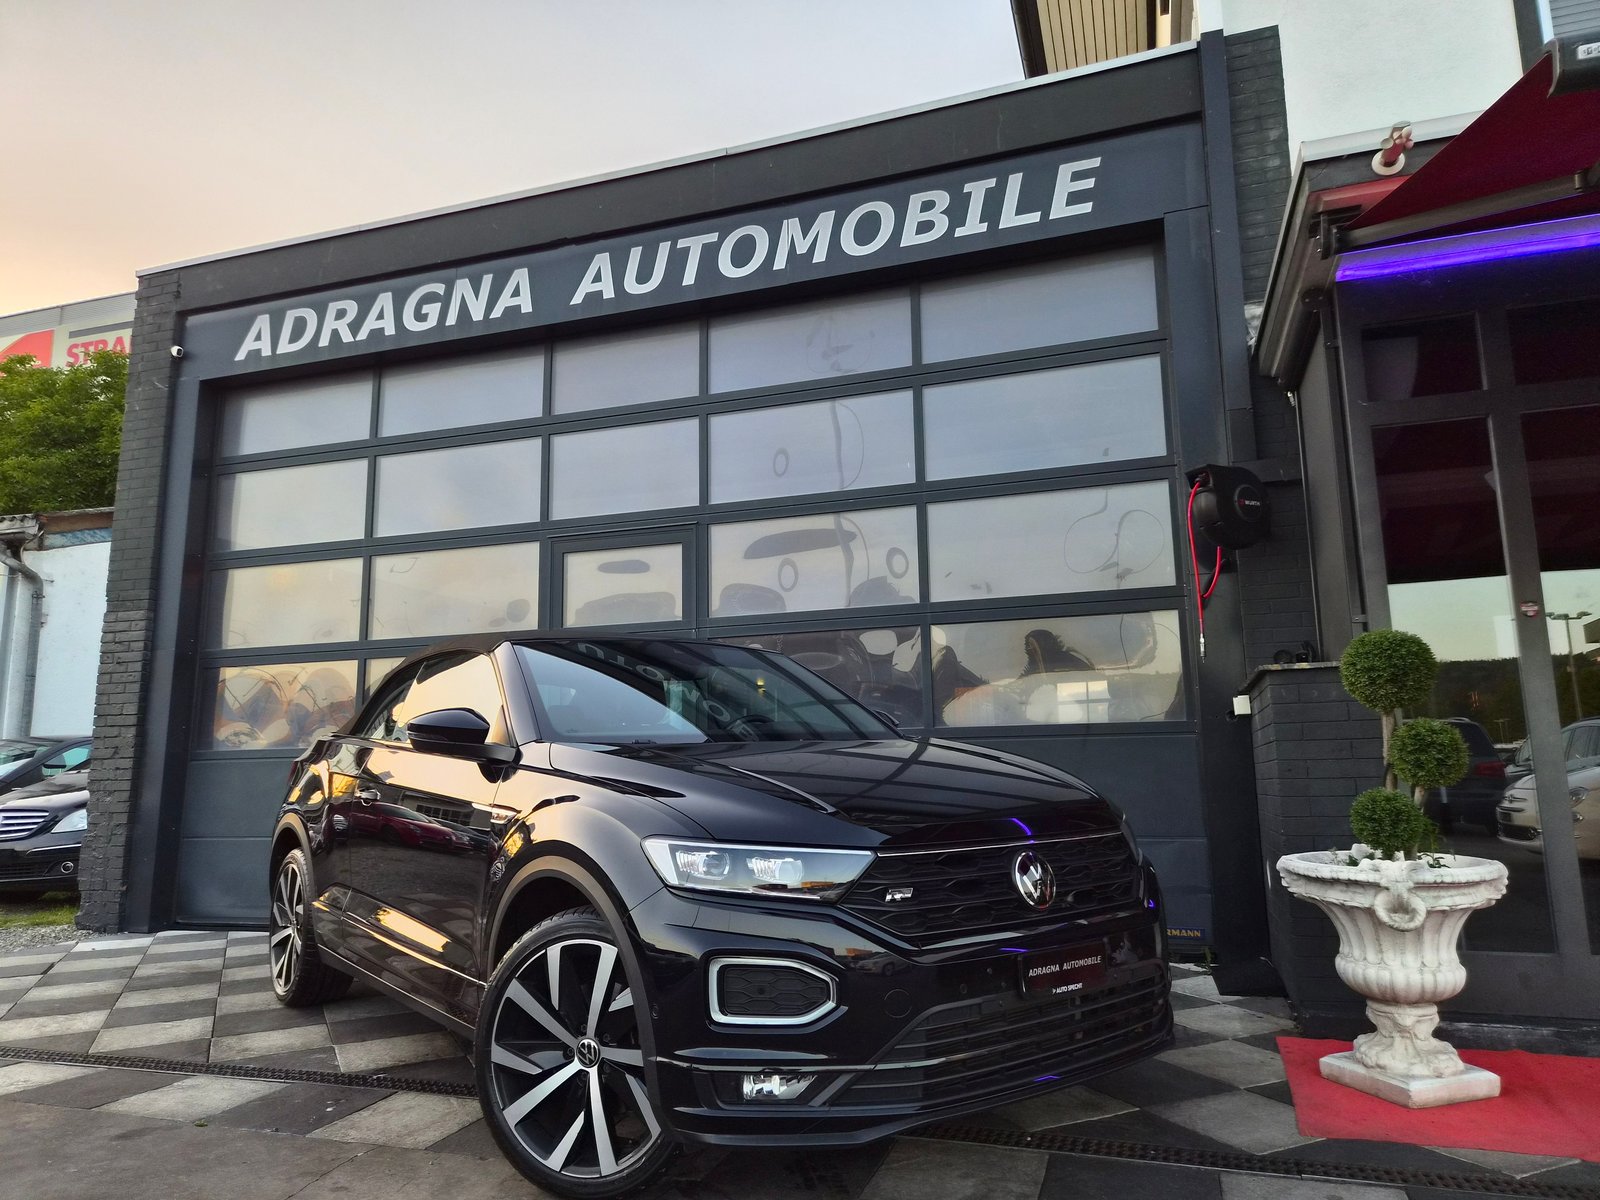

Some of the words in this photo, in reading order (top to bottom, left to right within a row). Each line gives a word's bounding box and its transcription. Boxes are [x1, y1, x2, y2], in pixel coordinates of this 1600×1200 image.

[234, 267, 533, 361] ADRAGNA
[569, 156, 1102, 305] AUTOMOBILE
[66, 335, 133, 367] STRA
[1028, 964, 1060, 977] ADRAGNA
[1062, 955, 1102, 970] AUTOMOBILE
[1056, 985, 1067, 994] AUTO
